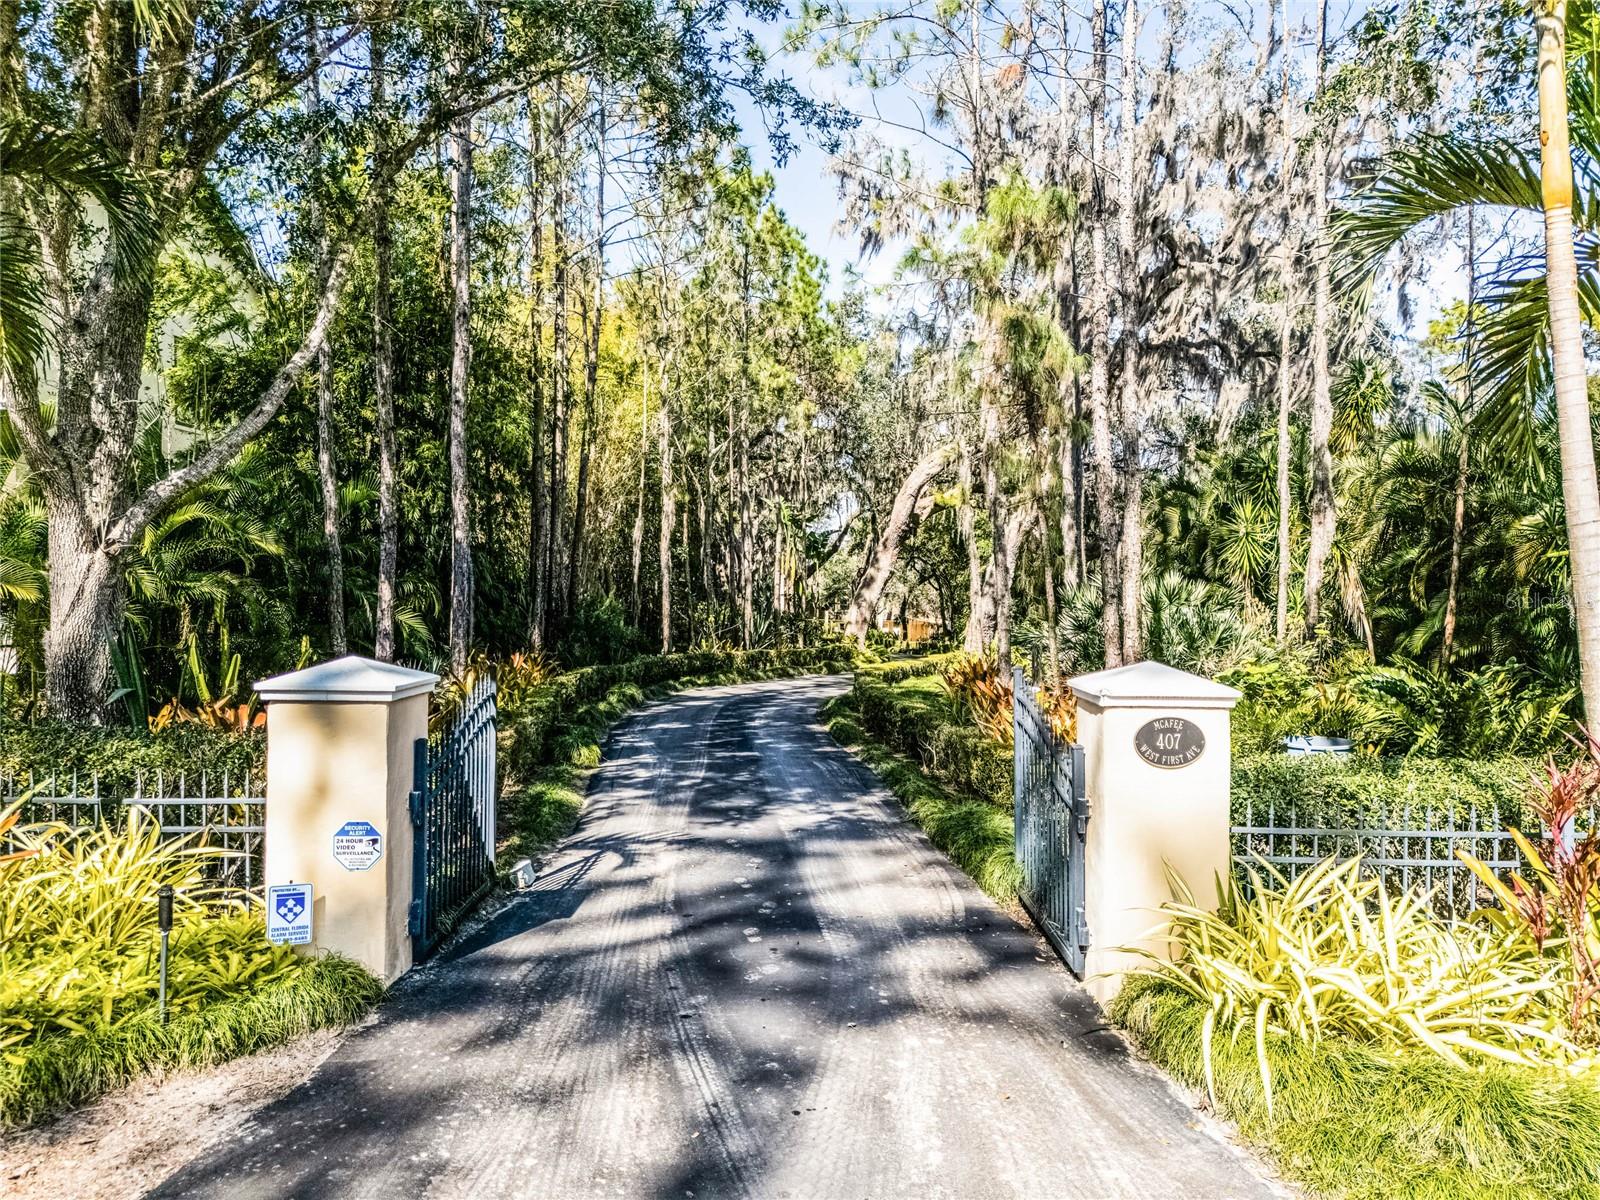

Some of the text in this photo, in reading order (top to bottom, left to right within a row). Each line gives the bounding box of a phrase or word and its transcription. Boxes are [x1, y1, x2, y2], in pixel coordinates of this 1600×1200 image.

[1154, 719, 1184, 731] MCAFEE
[1156, 733, 1182, 750] 407
[1140, 744, 1200, 764] WEST FIRST AVE
